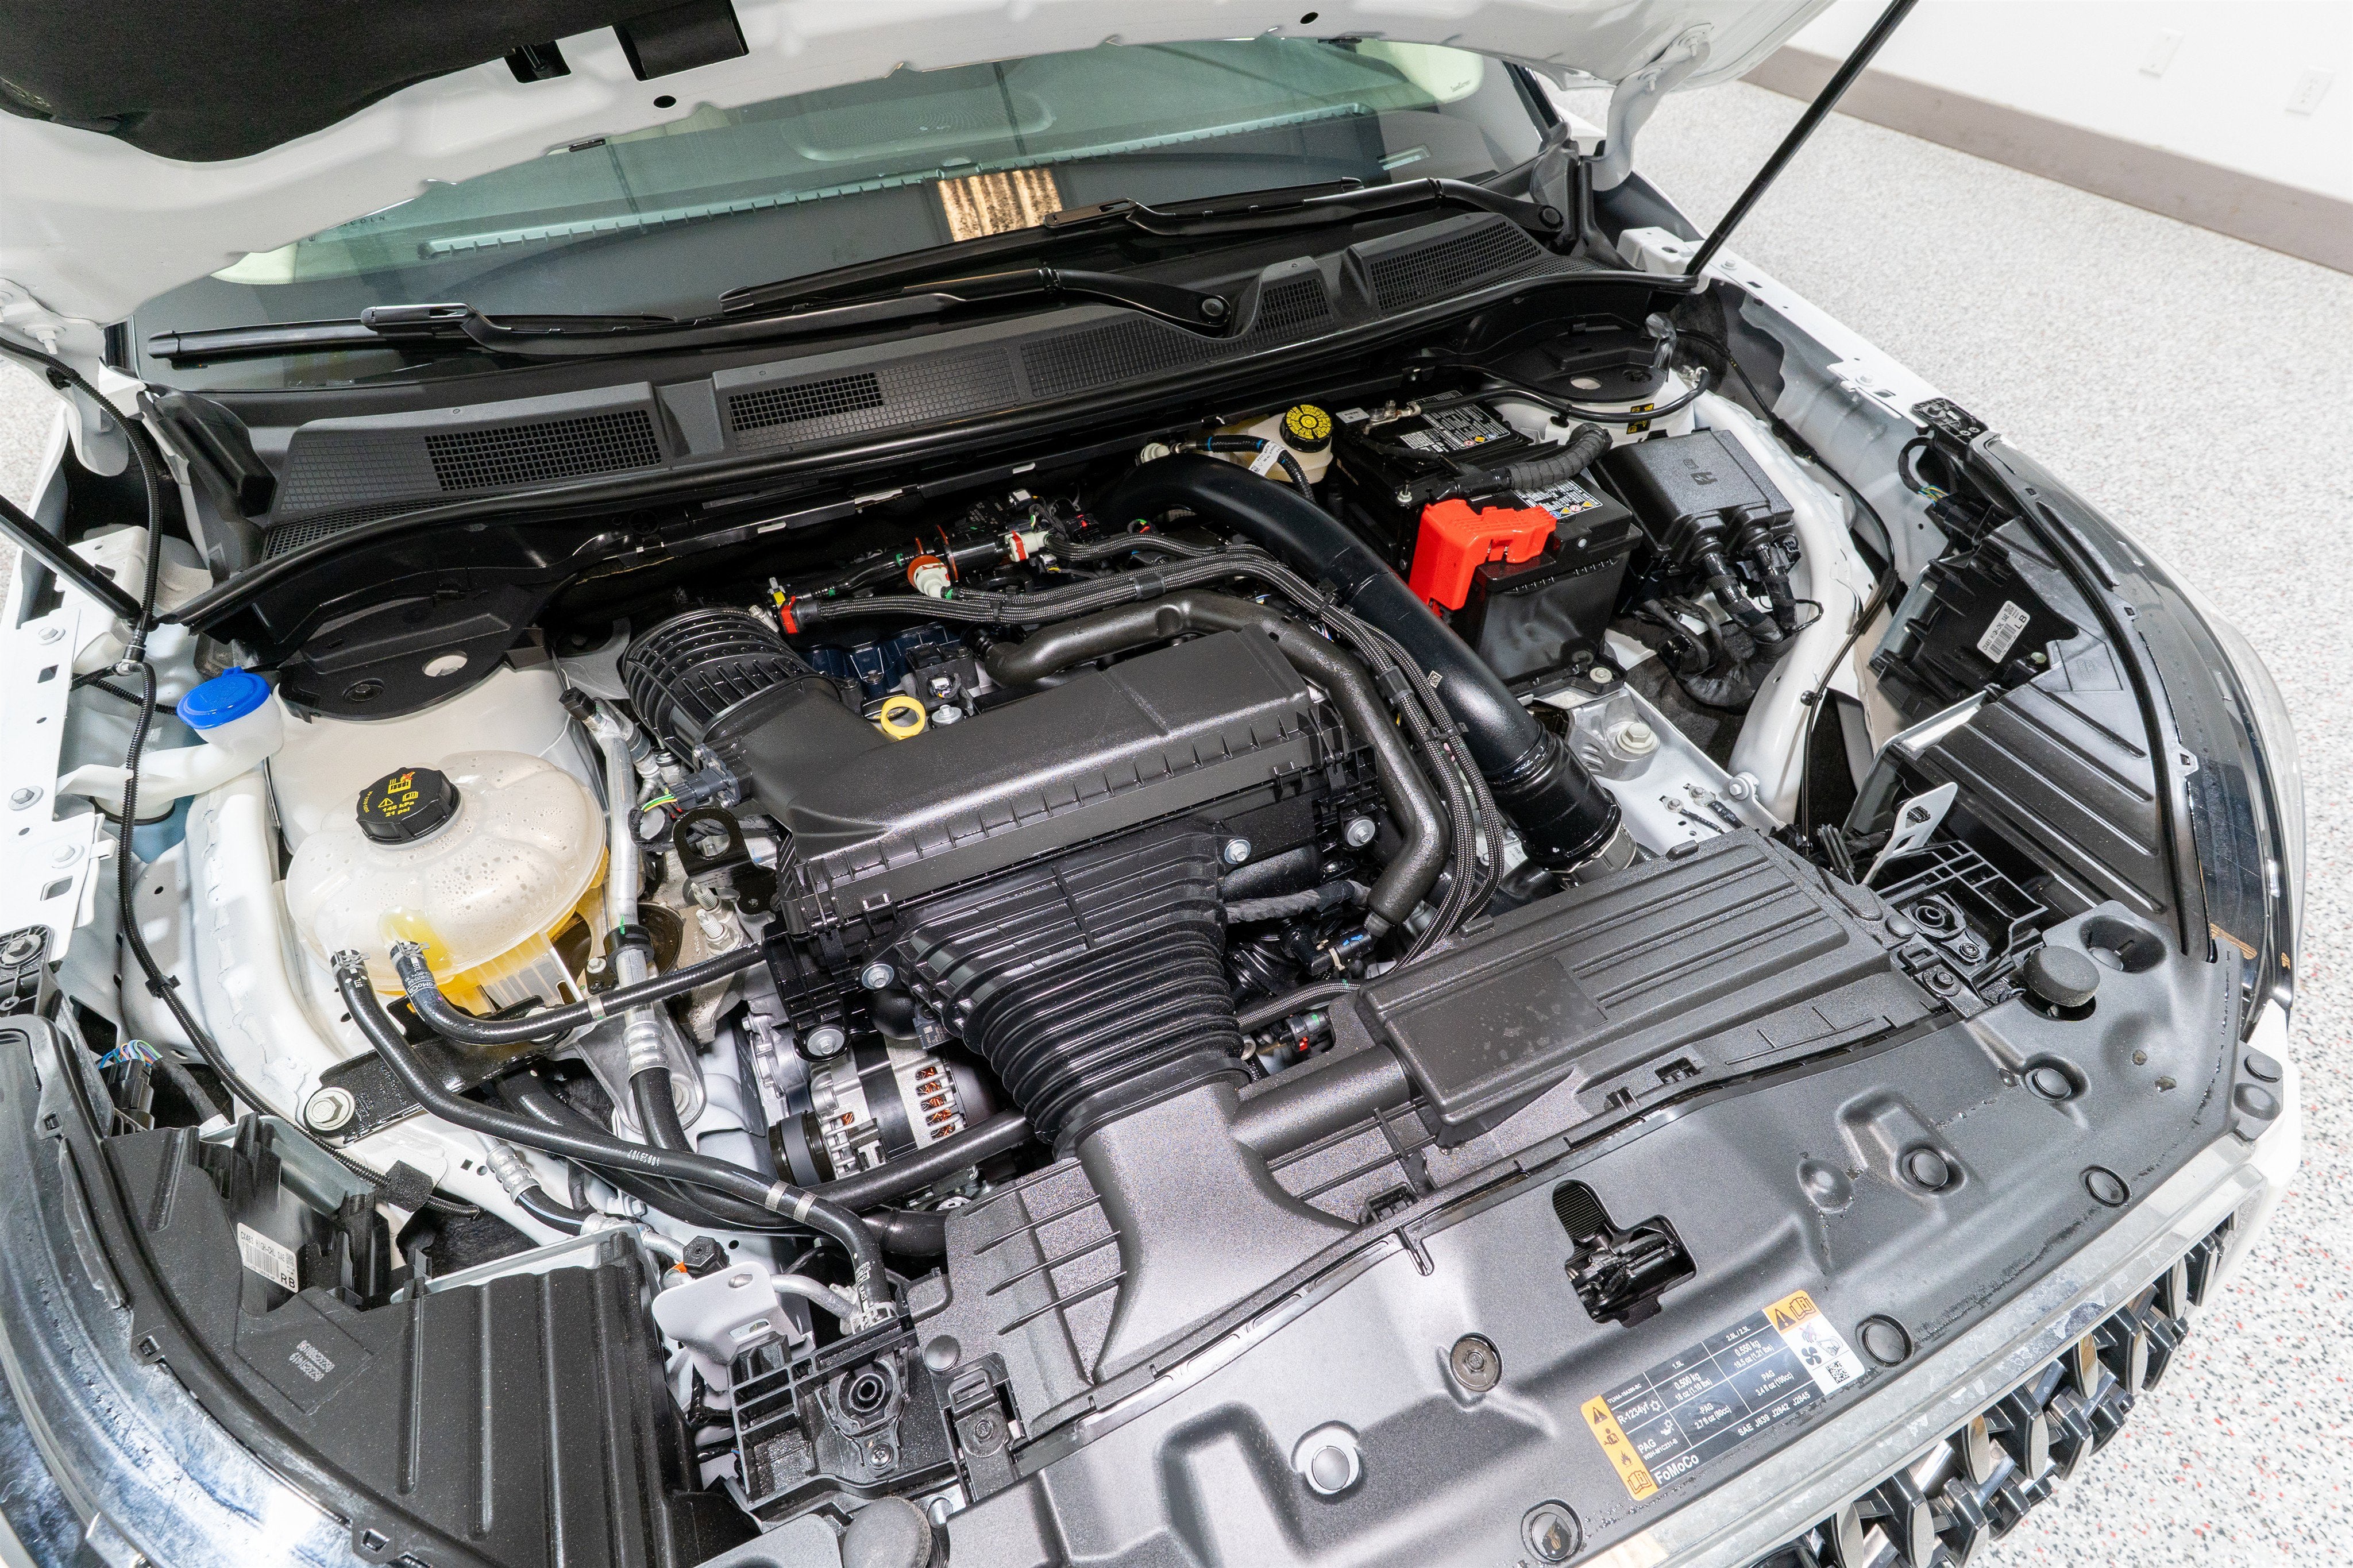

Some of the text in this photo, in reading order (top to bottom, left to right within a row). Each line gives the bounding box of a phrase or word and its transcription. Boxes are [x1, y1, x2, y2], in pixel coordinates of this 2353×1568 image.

[412, 963, 421, 972] BTL
[353, 978, 363, 988] BTL
[1726, 1331, 1738, 1342] 2.0L
[1739, 1326, 1750, 1335] 2.3L
[1734, 1339, 1761, 1357] 0.550 kg
[1734, 1344, 1775, 1369] 19.5 oz (1.21 lbs)
[1672, 1361, 1684, 1369] 1.5L
[1674, 1372, 1702, 1391] 0.500 kg
[1755, 1388, 1764, 1396] 3.4
[1763, 1384, 1769, 1393] fl
[1775, 1372, 1795, 1388] (100cc)
[1761, 1370, 1775, 1381] PAG
[1675, 1378, 1713, 1401] 18 oz (1.10 lbs)
[1617, 1402, 1649, 1424] R-1234yf
[1694, 1422, 1703, 1430] 2.7
[1702, 1418, 1708, 1426] fl
[1715, 1405, 1732, 1420] (80cc)
[1700, 1403, 1714, 1415] PAG
[1738, 1391, 1810, 1436] SAE J639 J2842 J2845
[1637, 1439, 1657, 1454] PAG
[1643, 1438, 1678, 1461] WSH-M1C231-B
[1654, 1454, 1699, 1484] FoMoCo
